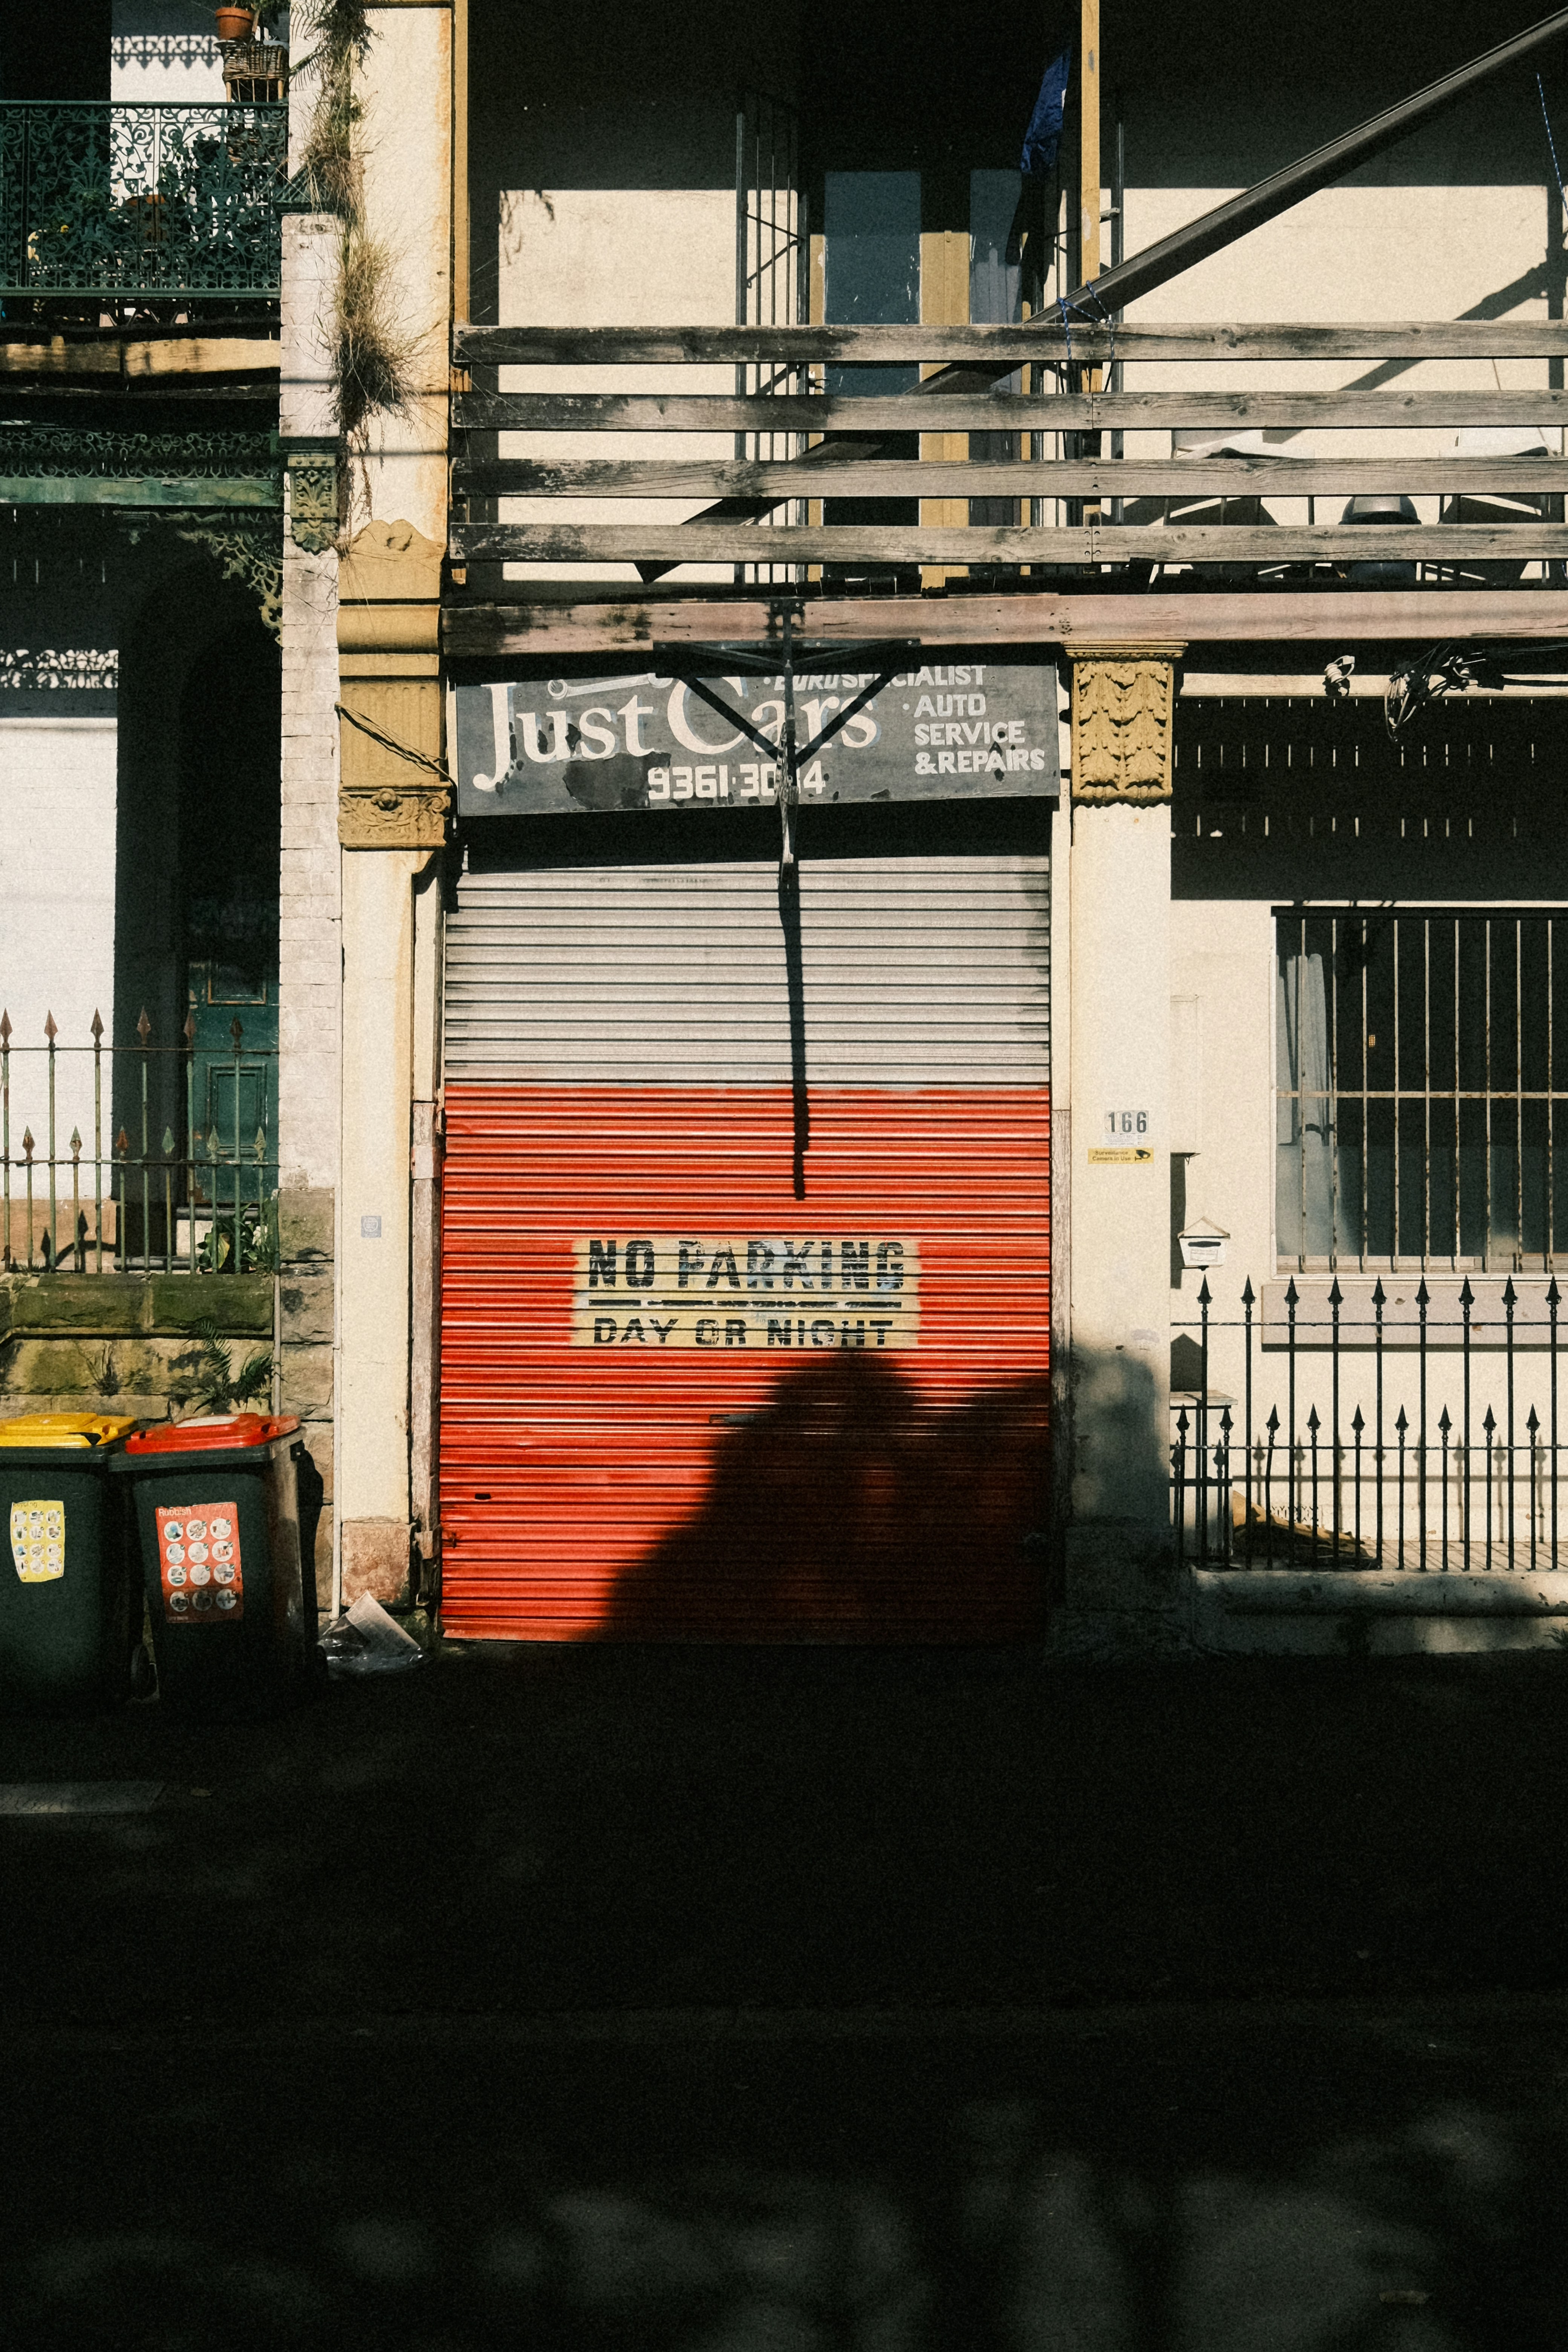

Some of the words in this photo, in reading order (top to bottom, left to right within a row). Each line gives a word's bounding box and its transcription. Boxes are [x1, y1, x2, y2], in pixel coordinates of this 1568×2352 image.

[914, 694, 986, 717] AUTO
[473, 683, 654, 790] Just
[667, 677, 877, 754] Cars
[914, 721, 1025, 746] SERVICE
[1108, 1112, 1147, 1133] 166
[589, 1240, 655, 1288] NO
[678, 1240, 904, 1289] PARKING
[593, 1318, 678, 1344] DAY
[695, 1319, 747, 1346] OR
[767, 1320, 893, 1346] NIGHT
